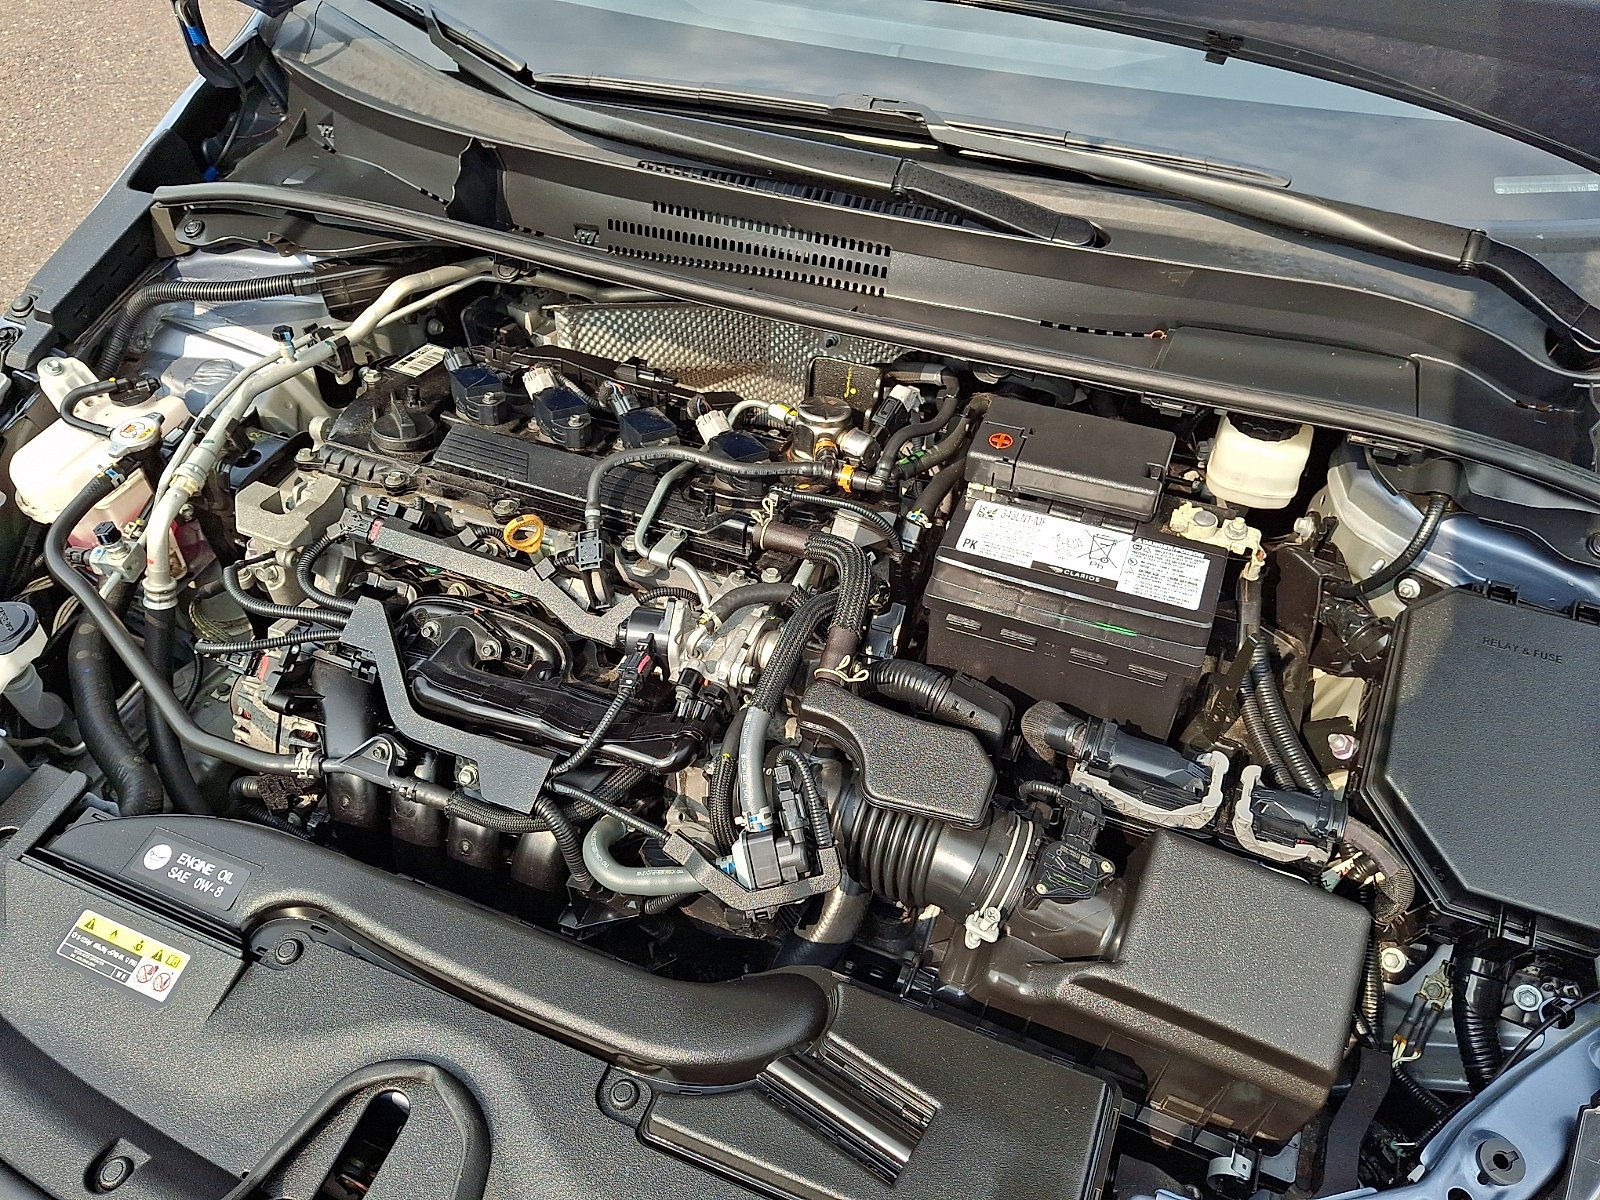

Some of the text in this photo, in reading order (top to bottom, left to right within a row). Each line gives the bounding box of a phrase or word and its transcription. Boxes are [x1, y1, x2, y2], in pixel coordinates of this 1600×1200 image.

[962, 538, 978, 550] PK
[1063, 569, 1101, 583] CLARIOS
[1482, 636, 1563, 664] RELAY & FUSE
[167, 866, 225, 898] SAE 0W-8
[176, 852, 235, 886] ENGINE OIL
